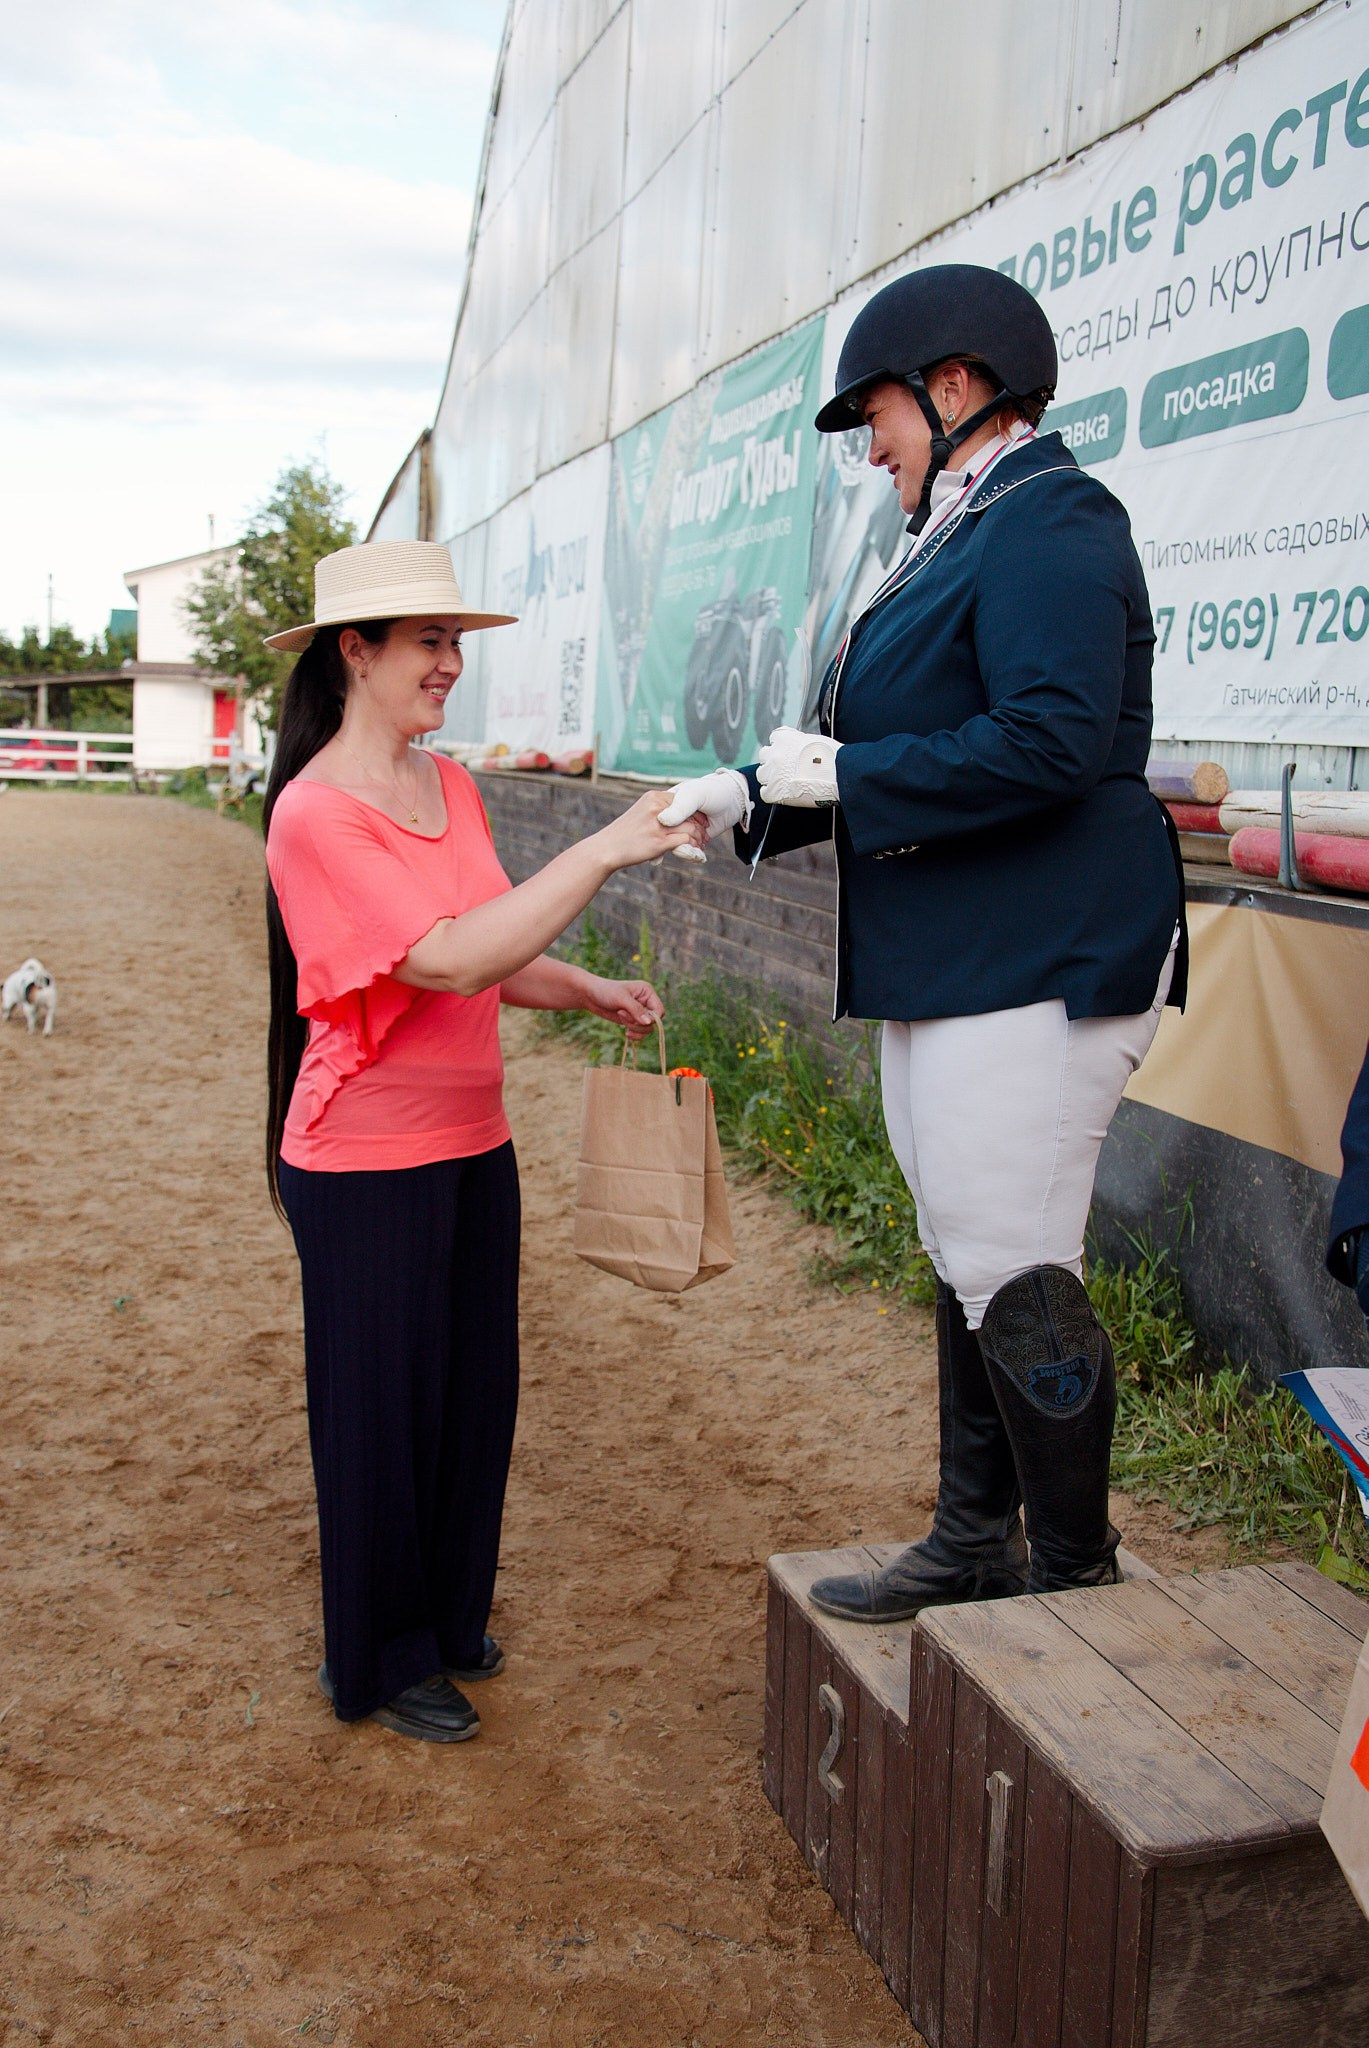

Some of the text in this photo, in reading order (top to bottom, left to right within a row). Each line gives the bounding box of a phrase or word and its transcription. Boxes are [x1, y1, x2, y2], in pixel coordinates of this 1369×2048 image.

[1173, 66, 1369, 256] расте
[1053, 201, 1369, 362] сады до крупно
[1163, 361, 1275, 421] посадка
[1059, 413, 1109, 448] авка
[740, 429, 802, 511] Туры
[1142, 531, 1257, 569] Питомник
[1187, 592, 1279, 665] (969)
[1293, 586, 1369, 646] 720
[1223, 681, 1321, 706] Гатчинский
[1326, 686, 1361, 710] р-н,
